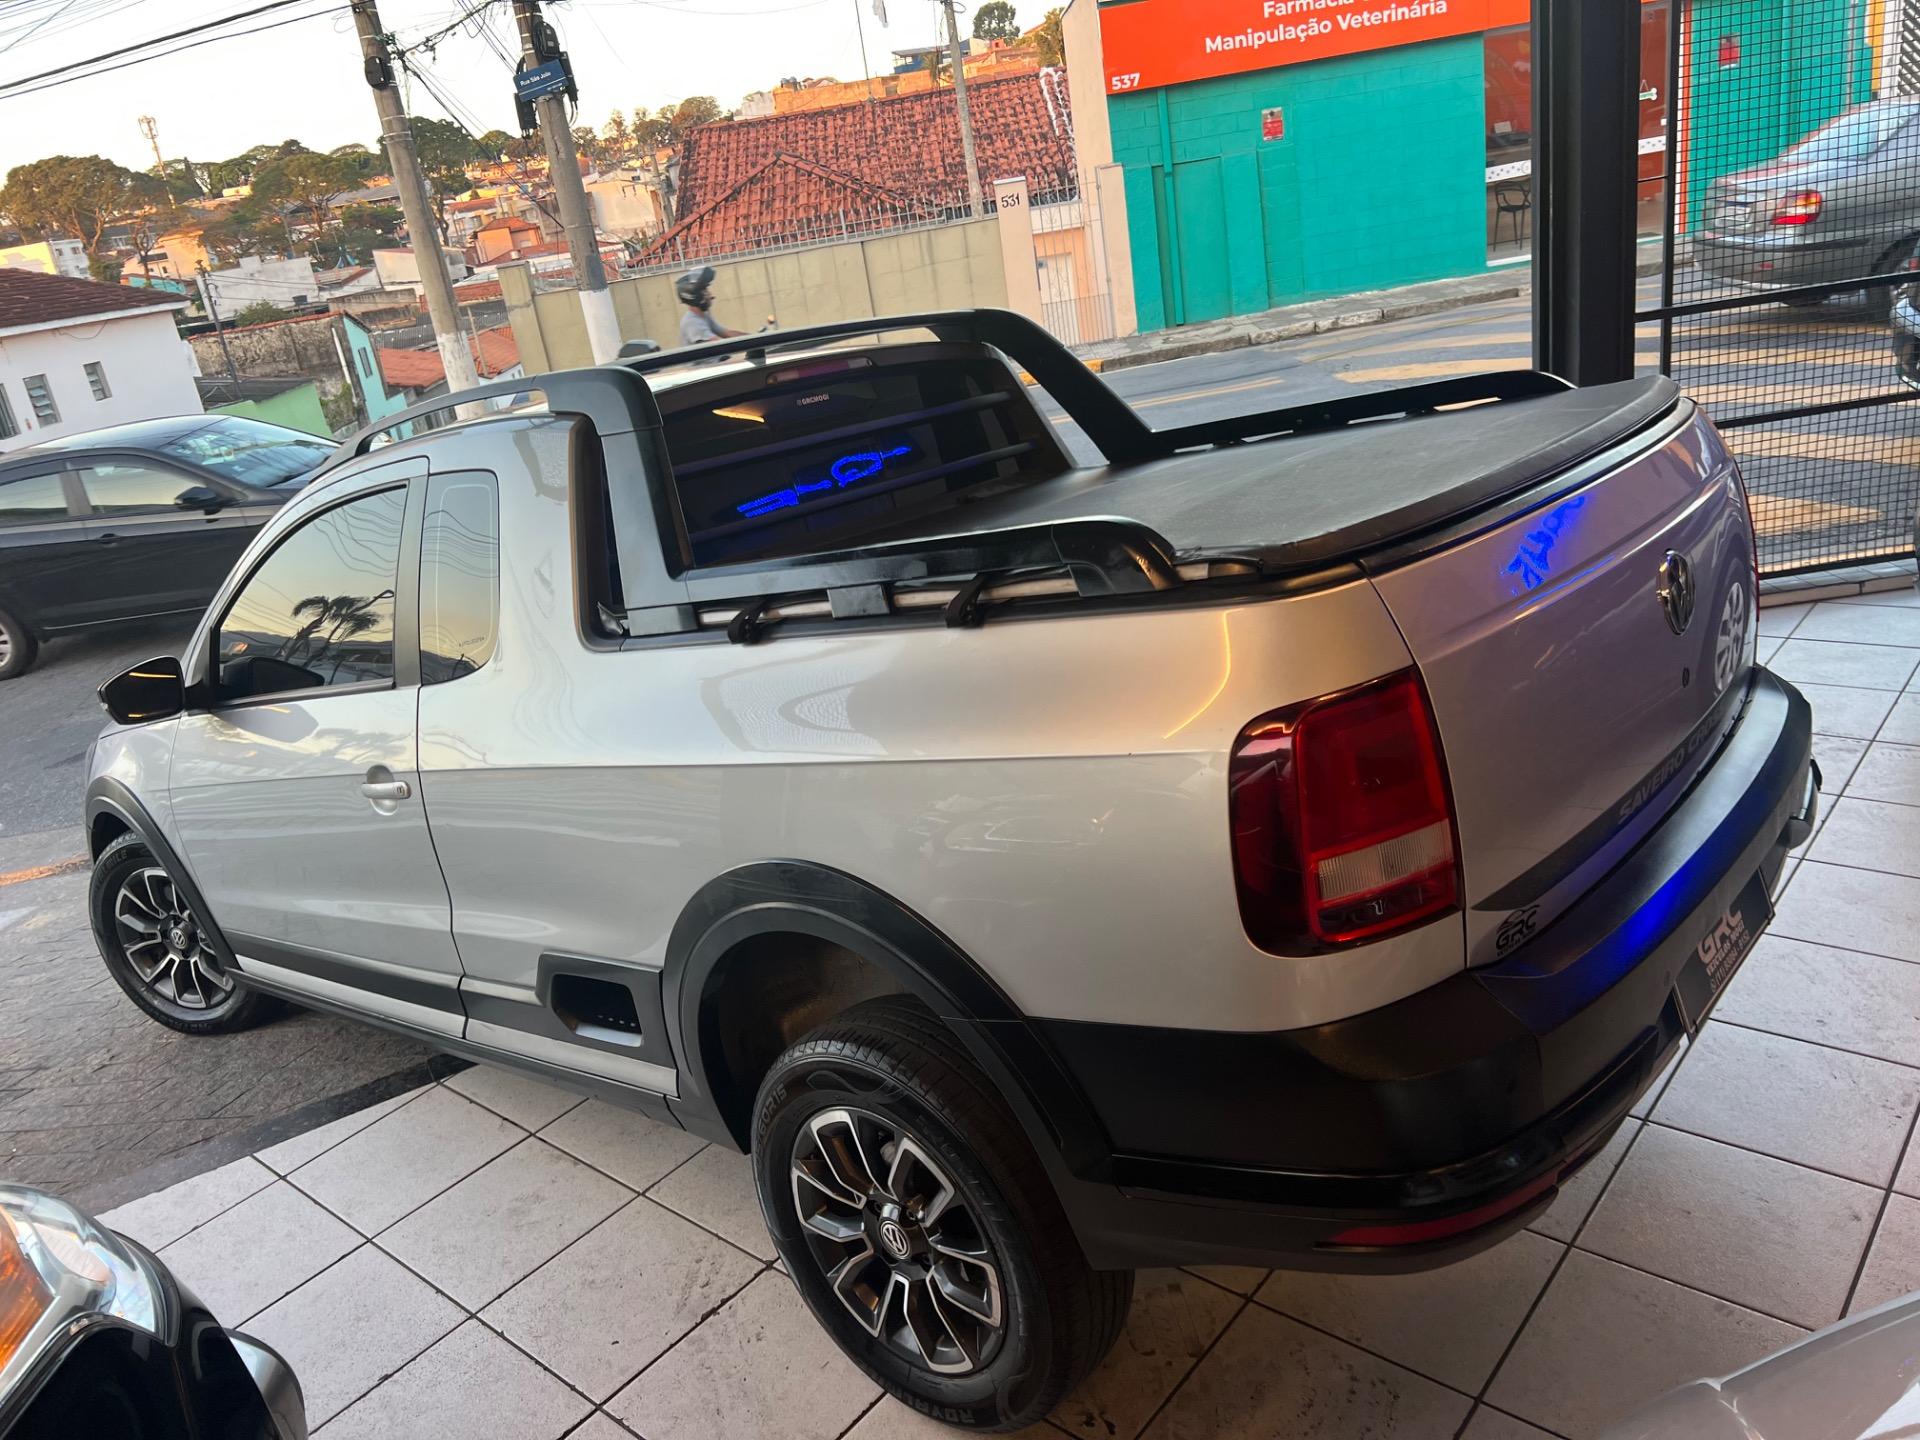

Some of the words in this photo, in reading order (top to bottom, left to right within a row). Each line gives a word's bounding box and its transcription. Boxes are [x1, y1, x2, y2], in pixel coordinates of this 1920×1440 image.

[1263, 0, 1355, 18] Farmc
[1205, 17, 1332, 53] Manipulação
[1336, 0, 1447, 31] Veterinária
[1111, 72, 1140, 90] 537
[1001, 193, 1020, 208] 531
[1618, 747, 1685, 824] SAVEIRO
